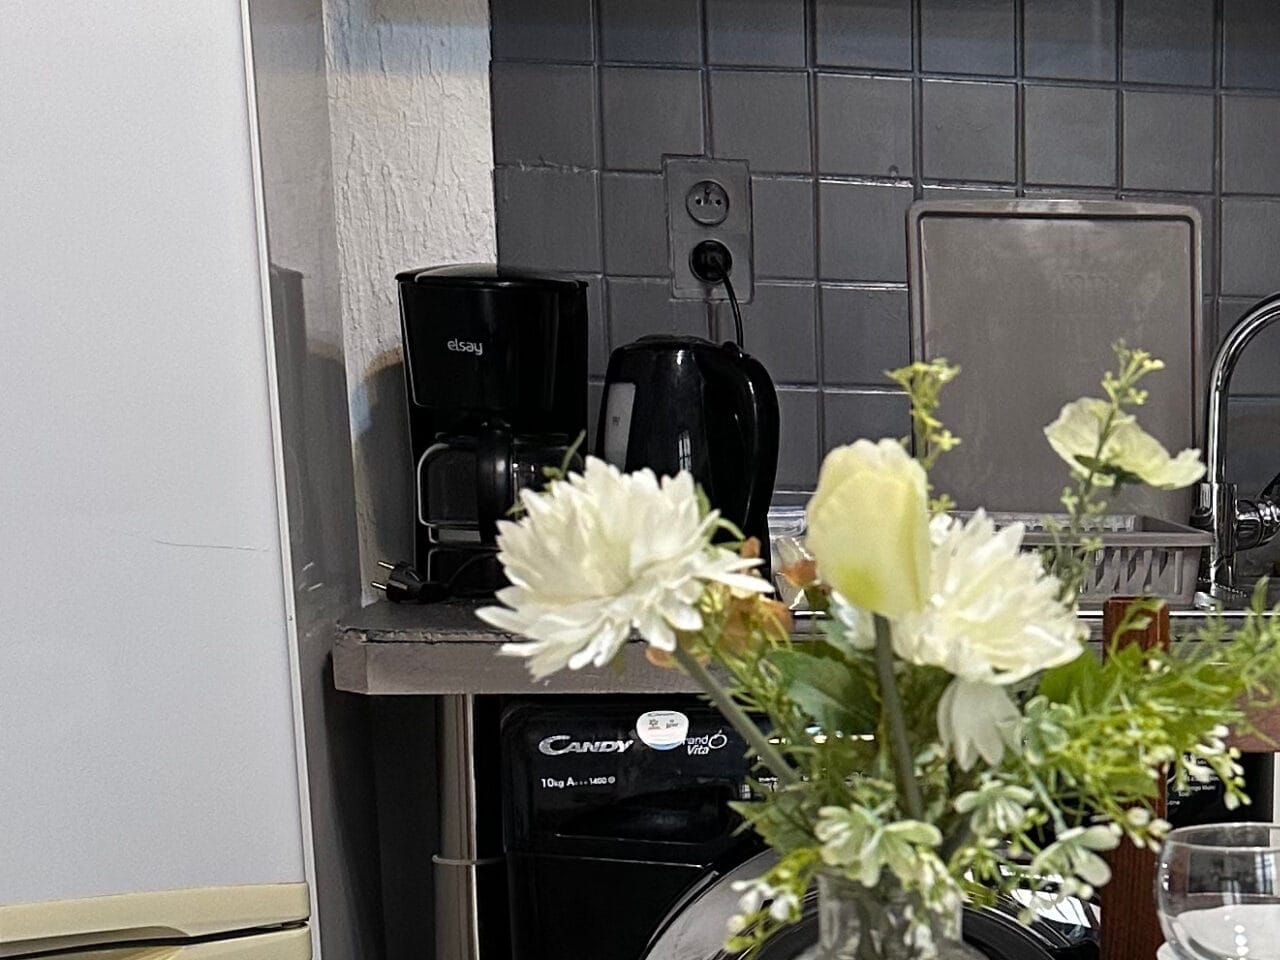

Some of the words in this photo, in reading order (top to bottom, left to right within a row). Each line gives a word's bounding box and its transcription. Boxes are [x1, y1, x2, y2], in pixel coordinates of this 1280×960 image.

[447, 338, 483, 356] elsay
[538, 735, 634, 756] CANDY
[687, 745, 710, 756] Vita
